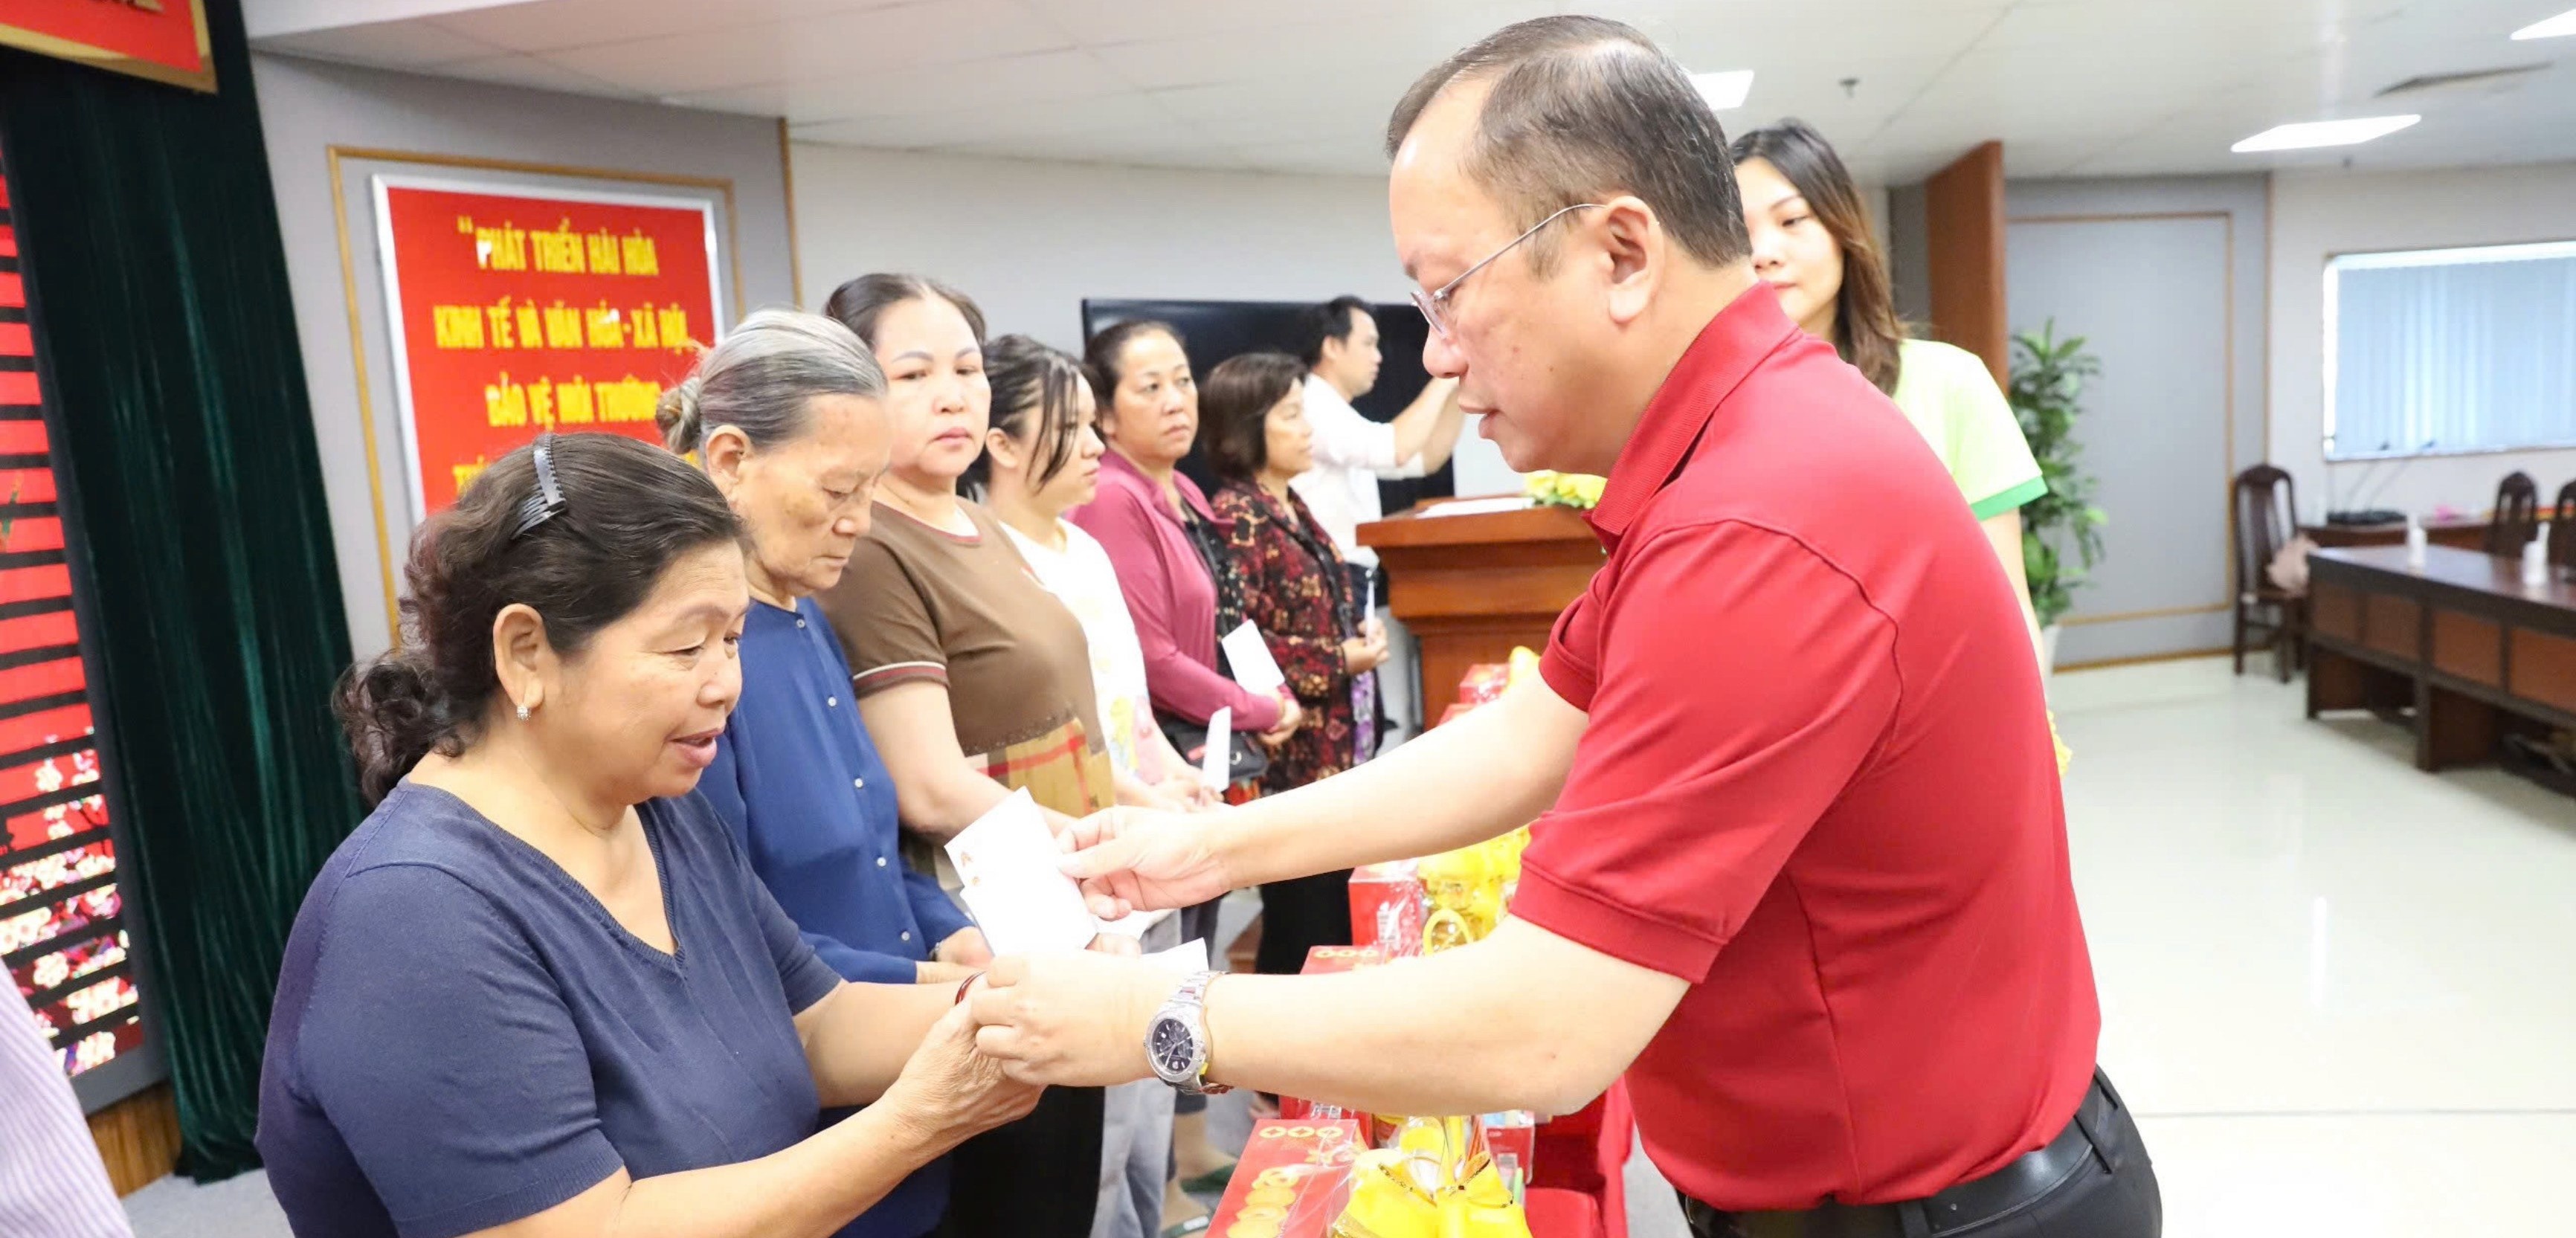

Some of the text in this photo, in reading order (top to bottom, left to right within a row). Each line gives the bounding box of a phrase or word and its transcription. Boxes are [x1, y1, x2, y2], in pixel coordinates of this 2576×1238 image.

[433, 305, 485, 349] KINH
[486, 295, 515, 349] TẾ
[515, 298, 544, 349] VÀ
[544, 299, 583, 349] VĂN
[485, 371, 528, 427] BẢO
[528, 375, 555, 431] VỆ
